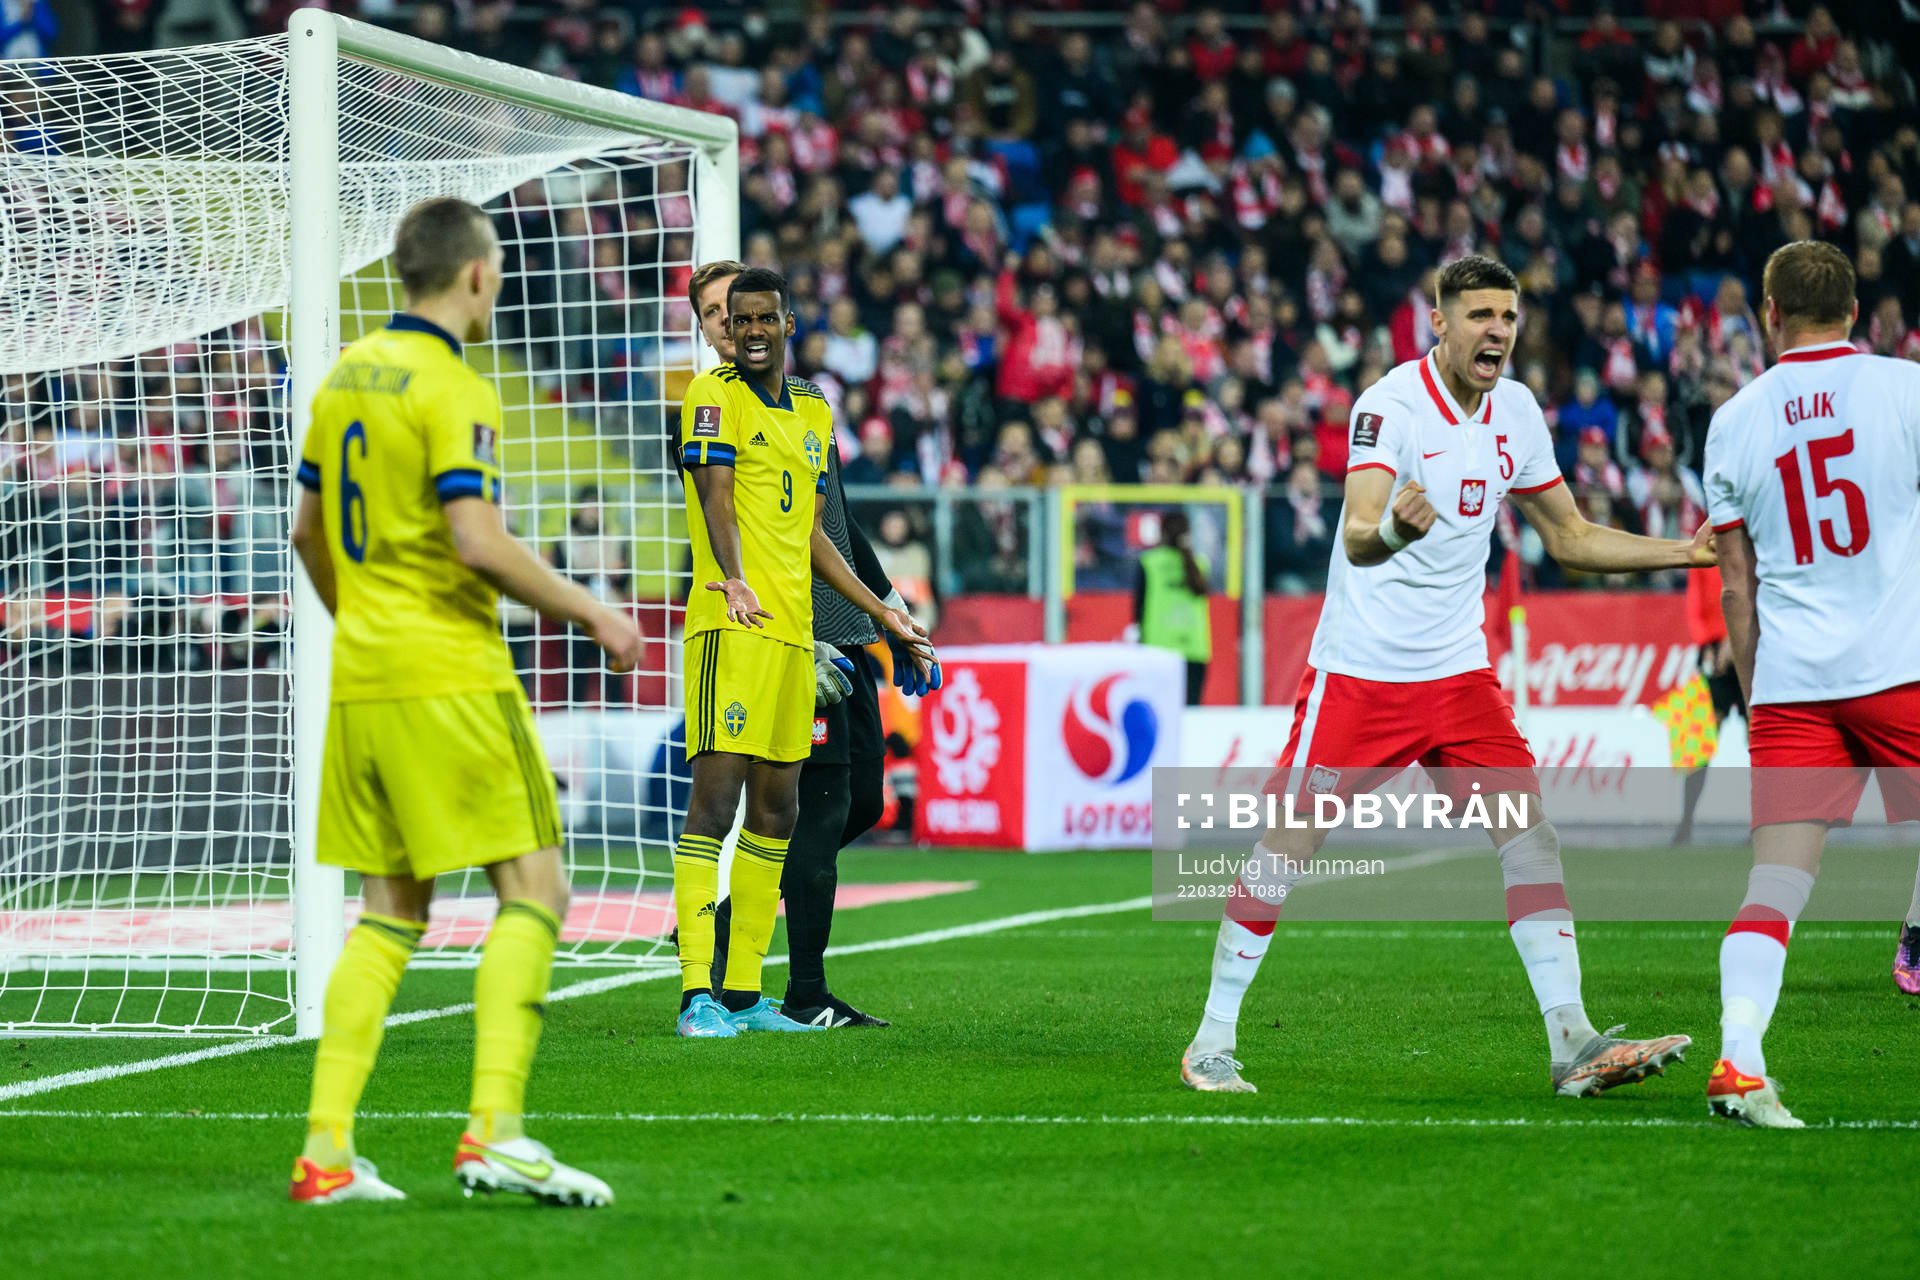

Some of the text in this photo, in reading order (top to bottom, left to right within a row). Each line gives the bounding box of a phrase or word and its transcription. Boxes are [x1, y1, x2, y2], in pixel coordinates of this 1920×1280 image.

[1784, 391, 1836, 426] GLIK
[1495, 434, 1514, 481] 5
[340, 420, 368, 564] 6
[779, 469, 793, 513] 9
[1774, 427, 1871, 566] 15
